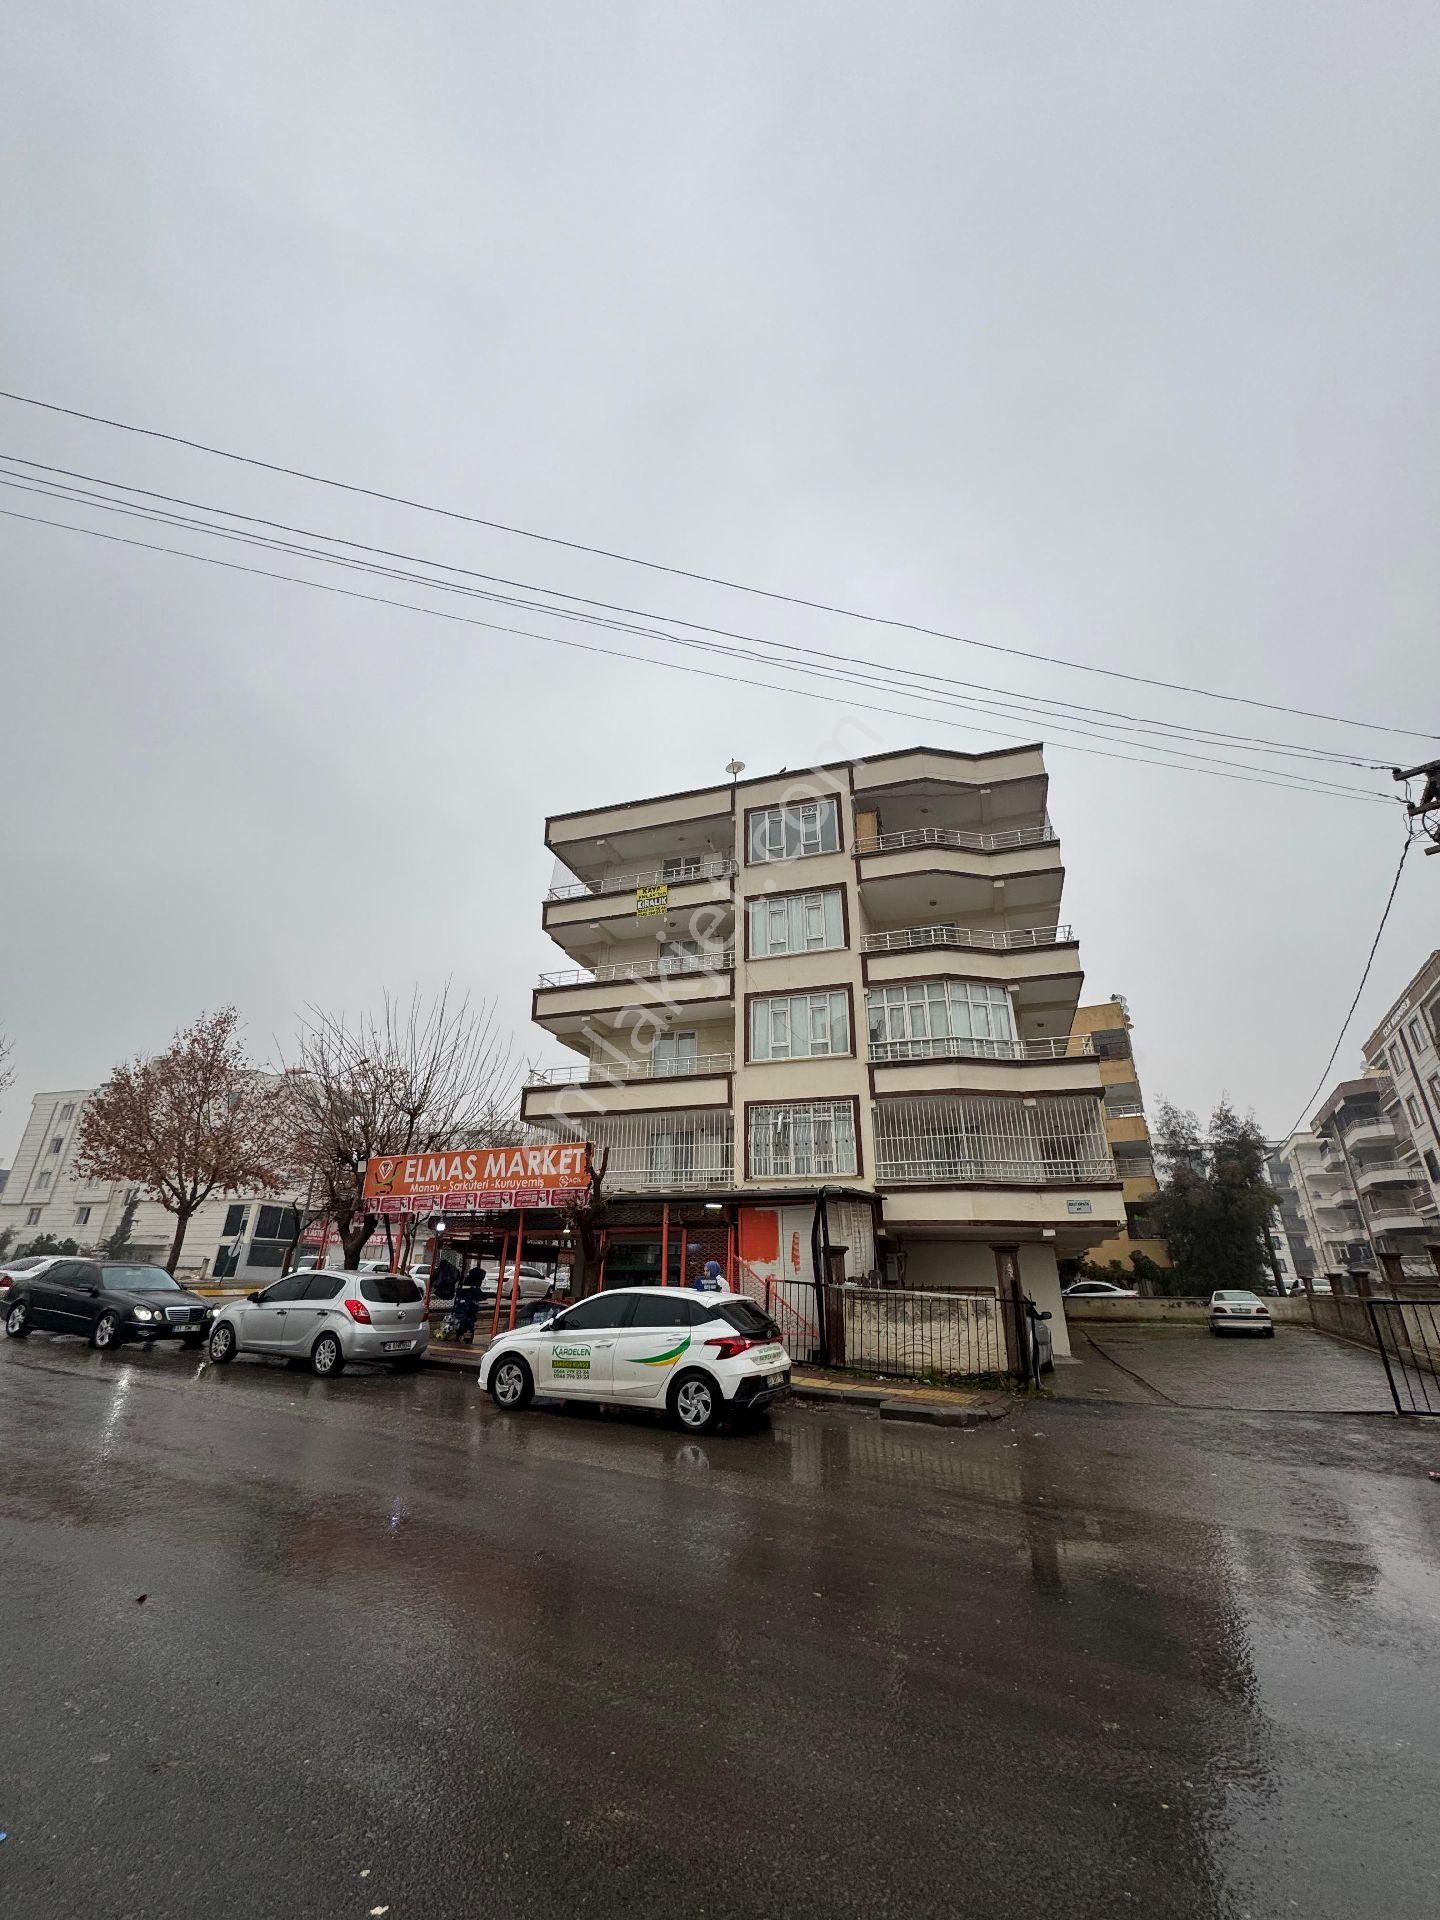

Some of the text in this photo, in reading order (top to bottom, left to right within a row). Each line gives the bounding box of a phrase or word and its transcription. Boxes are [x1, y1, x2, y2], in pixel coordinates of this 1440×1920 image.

[643, 886, 661, 894] KAYA
[403, 1147, 585, 1183] ELMAS MARKET
[410, 1182, 440, 1193] Manav
[449, 1179, 489, 1192] Şarküteri
[552, 1345, 591, 1358] KARDELEN
